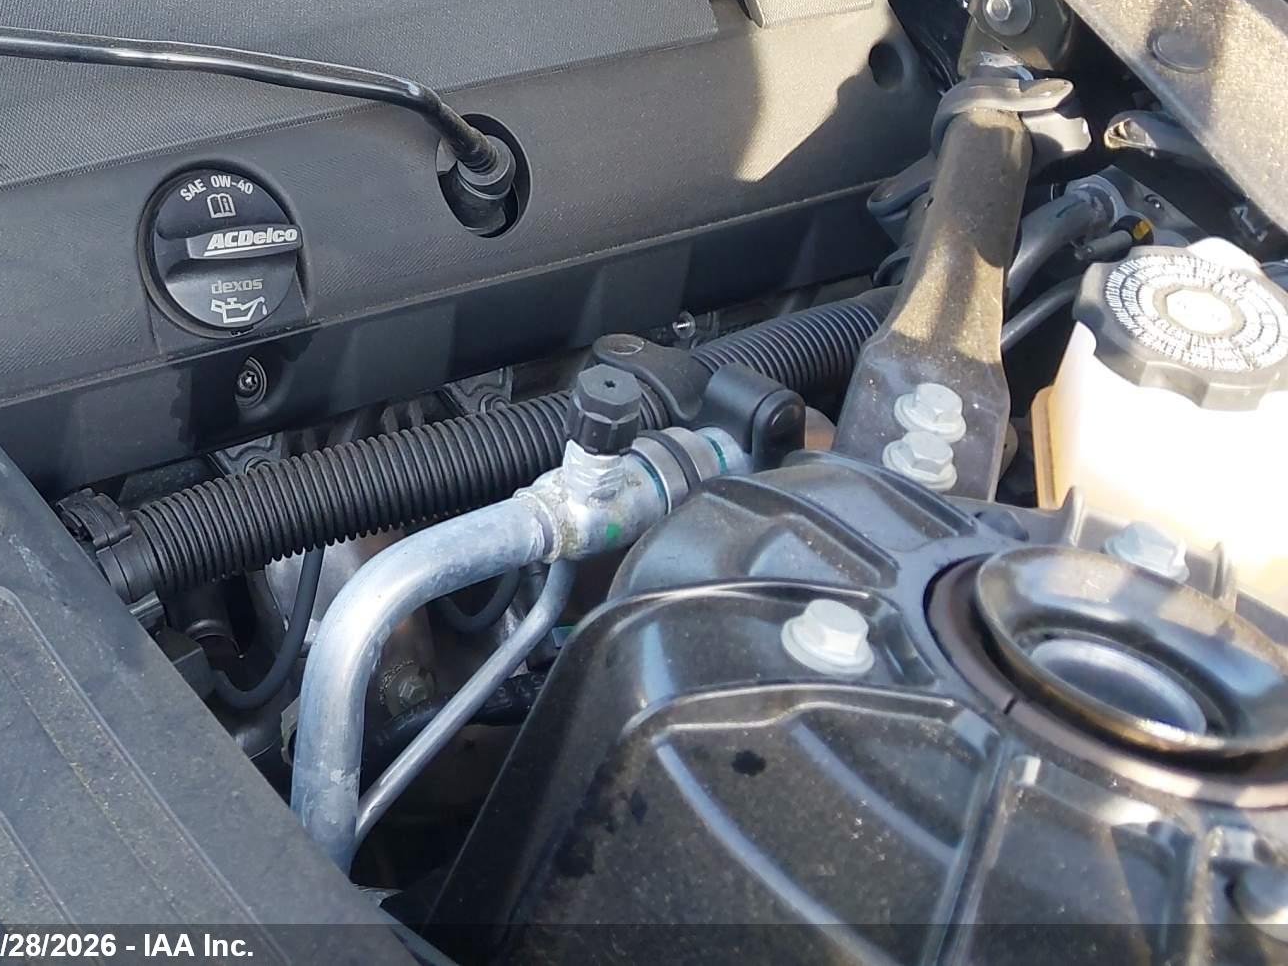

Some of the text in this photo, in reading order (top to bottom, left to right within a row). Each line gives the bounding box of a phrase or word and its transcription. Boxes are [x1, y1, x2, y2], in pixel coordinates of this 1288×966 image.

[180, 174, 254, 201] SAE 0W-40
[207, 227, 298, 250] ACDelco
[211, 278, 264, 295] dexos
